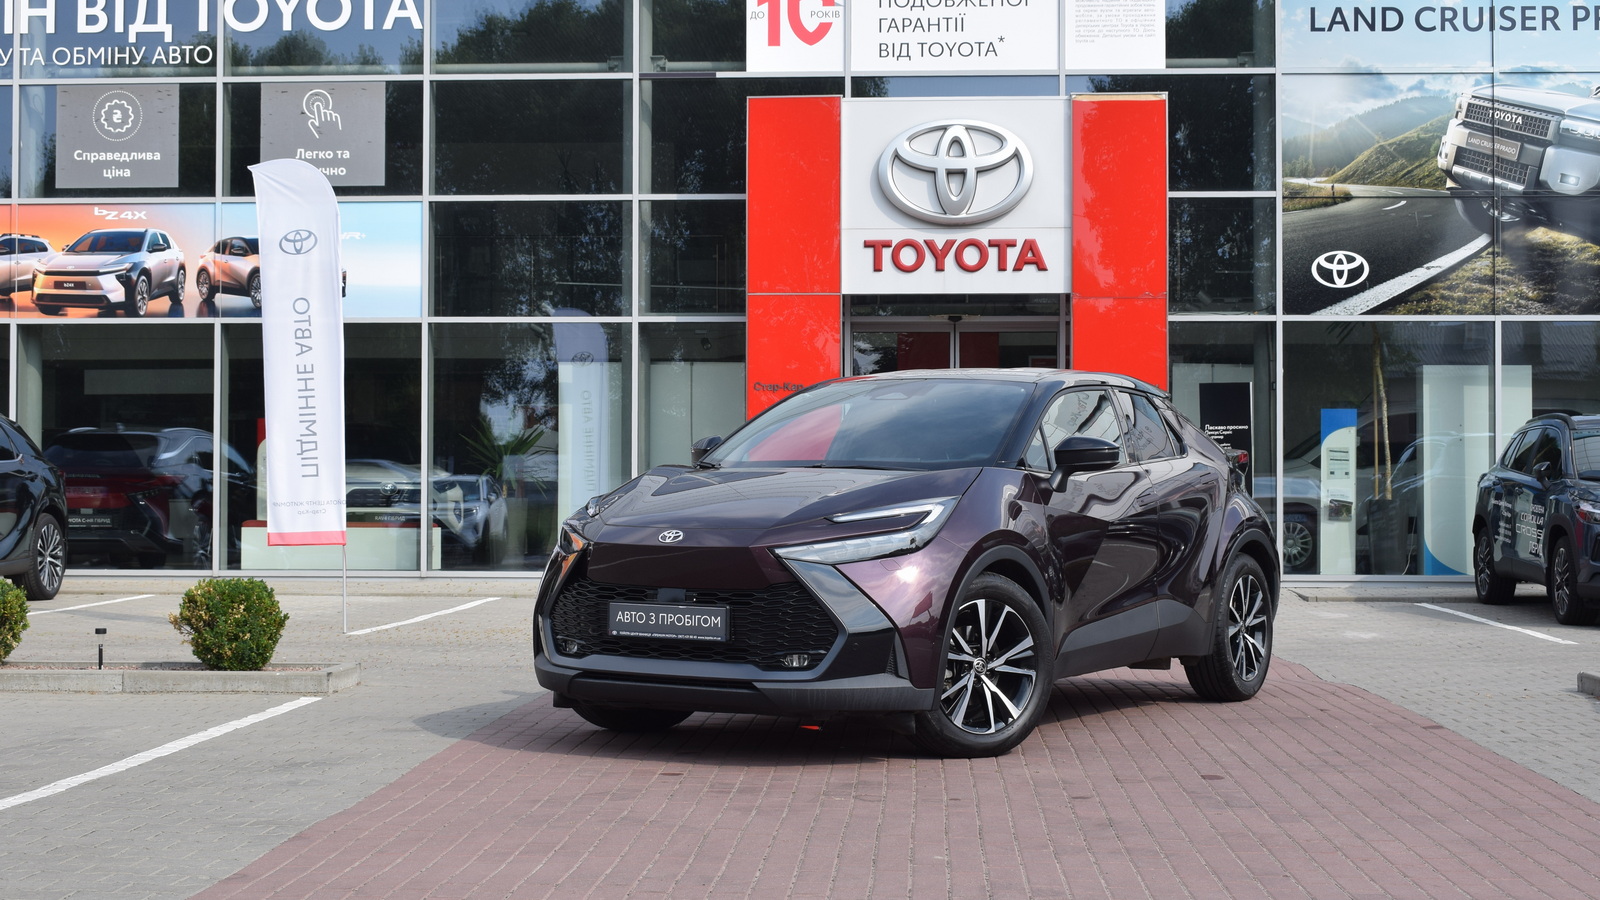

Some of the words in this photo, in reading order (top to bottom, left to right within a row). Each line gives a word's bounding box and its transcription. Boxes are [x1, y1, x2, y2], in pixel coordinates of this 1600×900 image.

[77, 0, 173, 43] ВІД
[198, 0, 423, 32] TOYOTA
[750, 11, 765, 20] ДО
[810, 10, 841, 18] РОКІВ
[878, 13, 966, 33] ГАРАНТІЇ
[1310, 6, 1404, 32] LAND
[1414, 5, 1561, 32] CRUISER
[20, 48, 45, 66] ТА
[52, 46, 146, 66] ОБМІНУ
[151, 45, 213, 65] АВТО
[878, 42, 911, 61] ВІД
[1488, 110, 1523, 125] TOYOTA
[295, 148, 334, 159] Легко
[336, 150, 350, 159] та
[1467, 137, 1480, 145] LAND
[1500, 145, 1516, 154] PRADO
[73, 149, 161, 163] Справедлива
[103, 166, 131, 179] ціна
[320, 167, 347, 176] чно
[863, 238, 1049, 273] TOYOTA
[1515, 523, 1543, 539] CROSS
[616, 611, 646, 624] АВТО
[648, 612, 656, 625] З
[659, 613, 721, 628] ПРОБІГОМ
